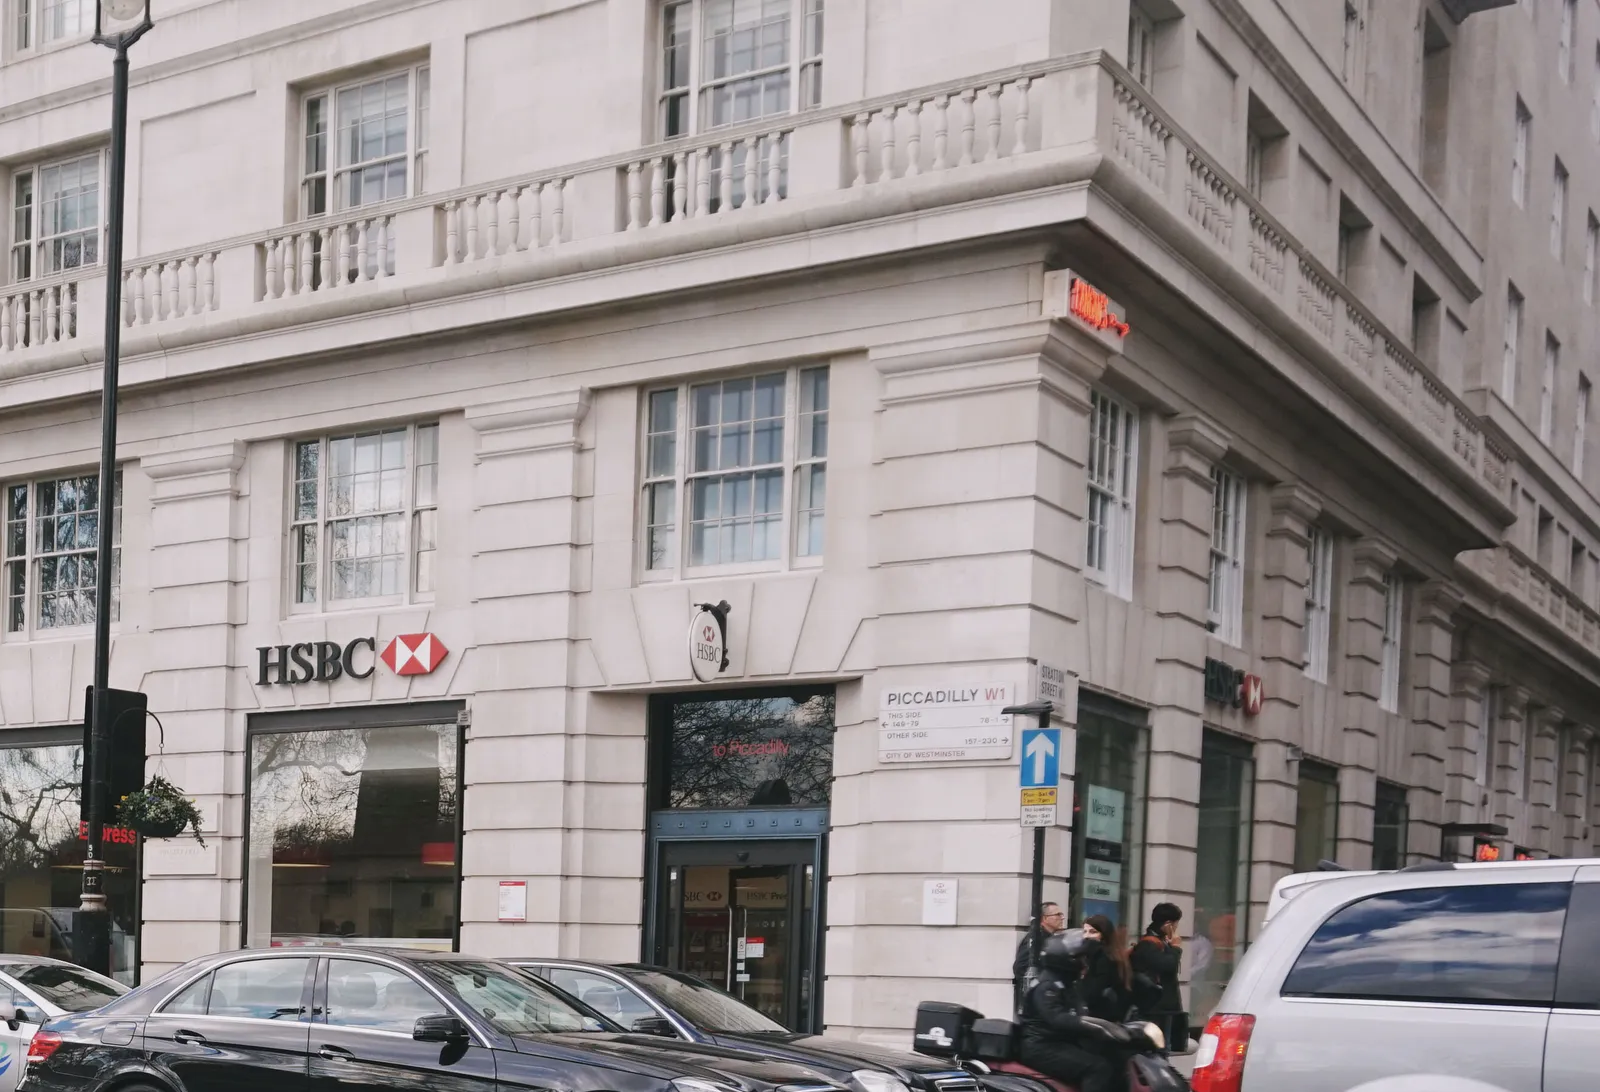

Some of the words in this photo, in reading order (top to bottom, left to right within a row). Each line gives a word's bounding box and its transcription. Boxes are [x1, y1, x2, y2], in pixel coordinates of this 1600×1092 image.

[255, 637, 376, 686] HSBC
[697, 642, 721, 664] HSBC
[887, 688, 979, 706] PICCADILLY
[984, 687, 1006, 701] W1
[905, 711, 922, 719] SIDE
[887, 731, 910, 740] OTHER
[912, 731, 928, 739] SIDE
[713, 744, 726, 757] to
[729, 738, 791, 756] Piccadilly
[886, 752, 901, 760] CITY
[915, 750, 966, 759] WESTMINSTER
[79, 820, 137, 845] Eress
[684, 891, 704, 901] SBC
